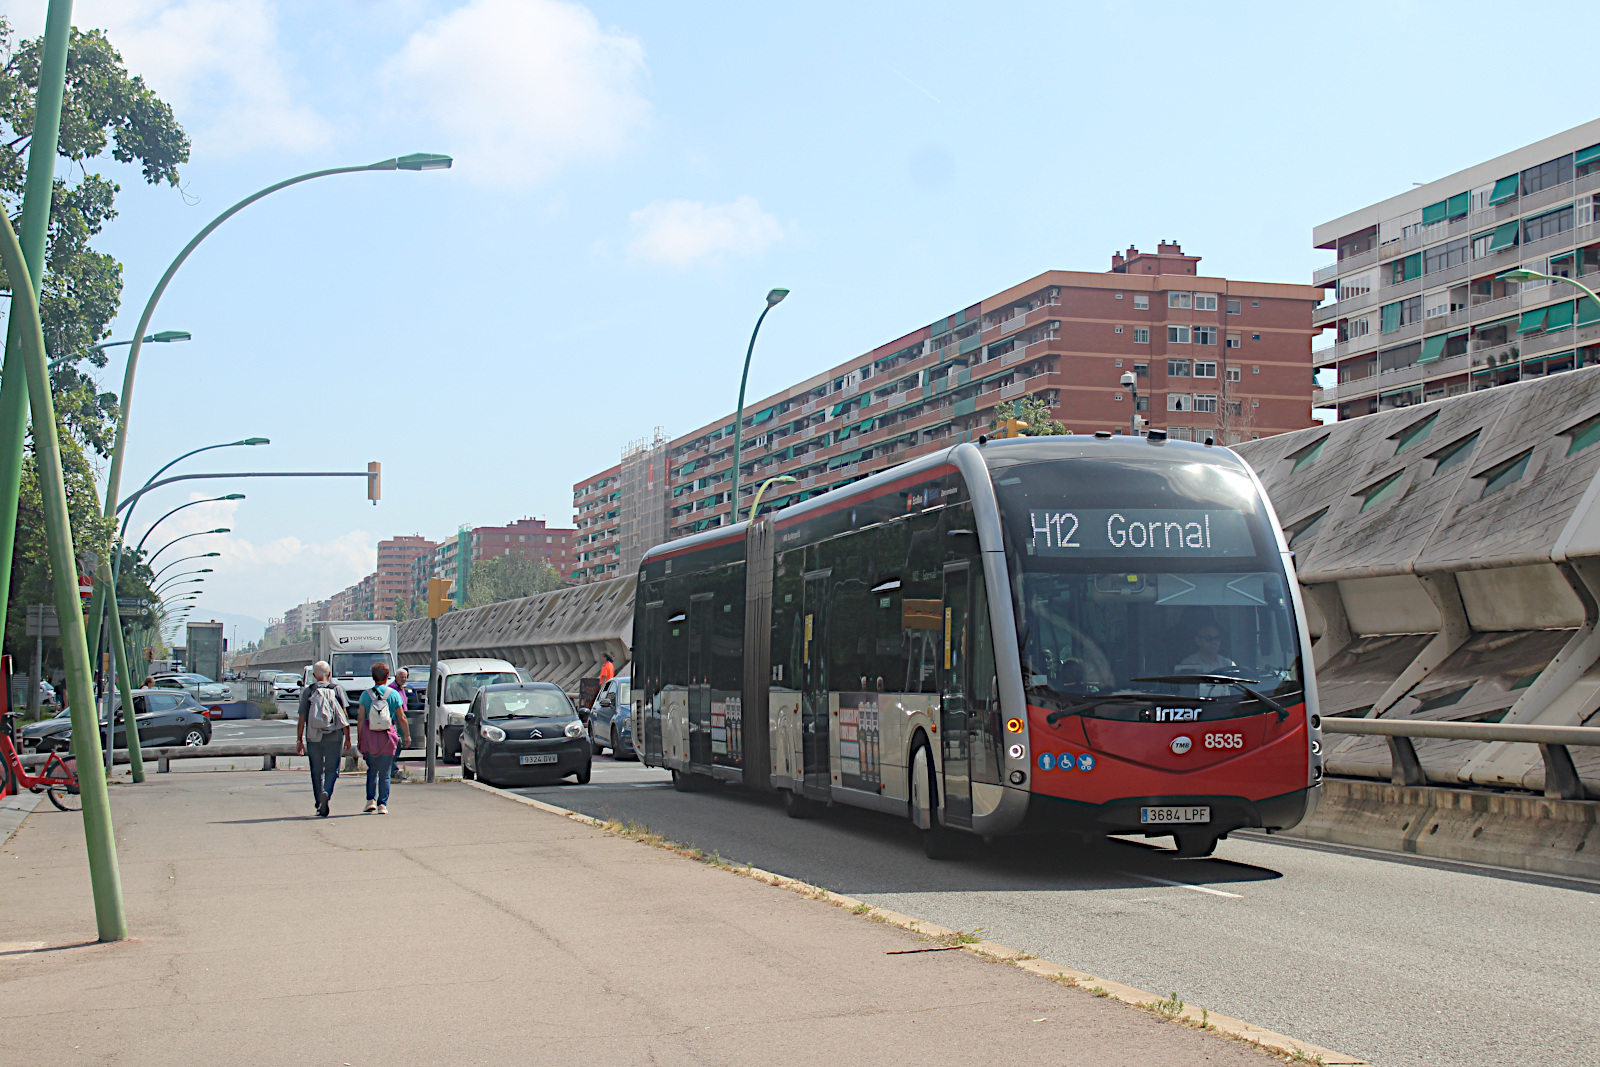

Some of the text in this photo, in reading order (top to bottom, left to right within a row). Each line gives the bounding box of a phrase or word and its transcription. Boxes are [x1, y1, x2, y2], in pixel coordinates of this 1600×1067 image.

[1031, 512, 1211, 548] H12 Gornal
[1205, 733, 1243, 748] 8535
[1150, 809, 1207, 821] 3684 LPF
